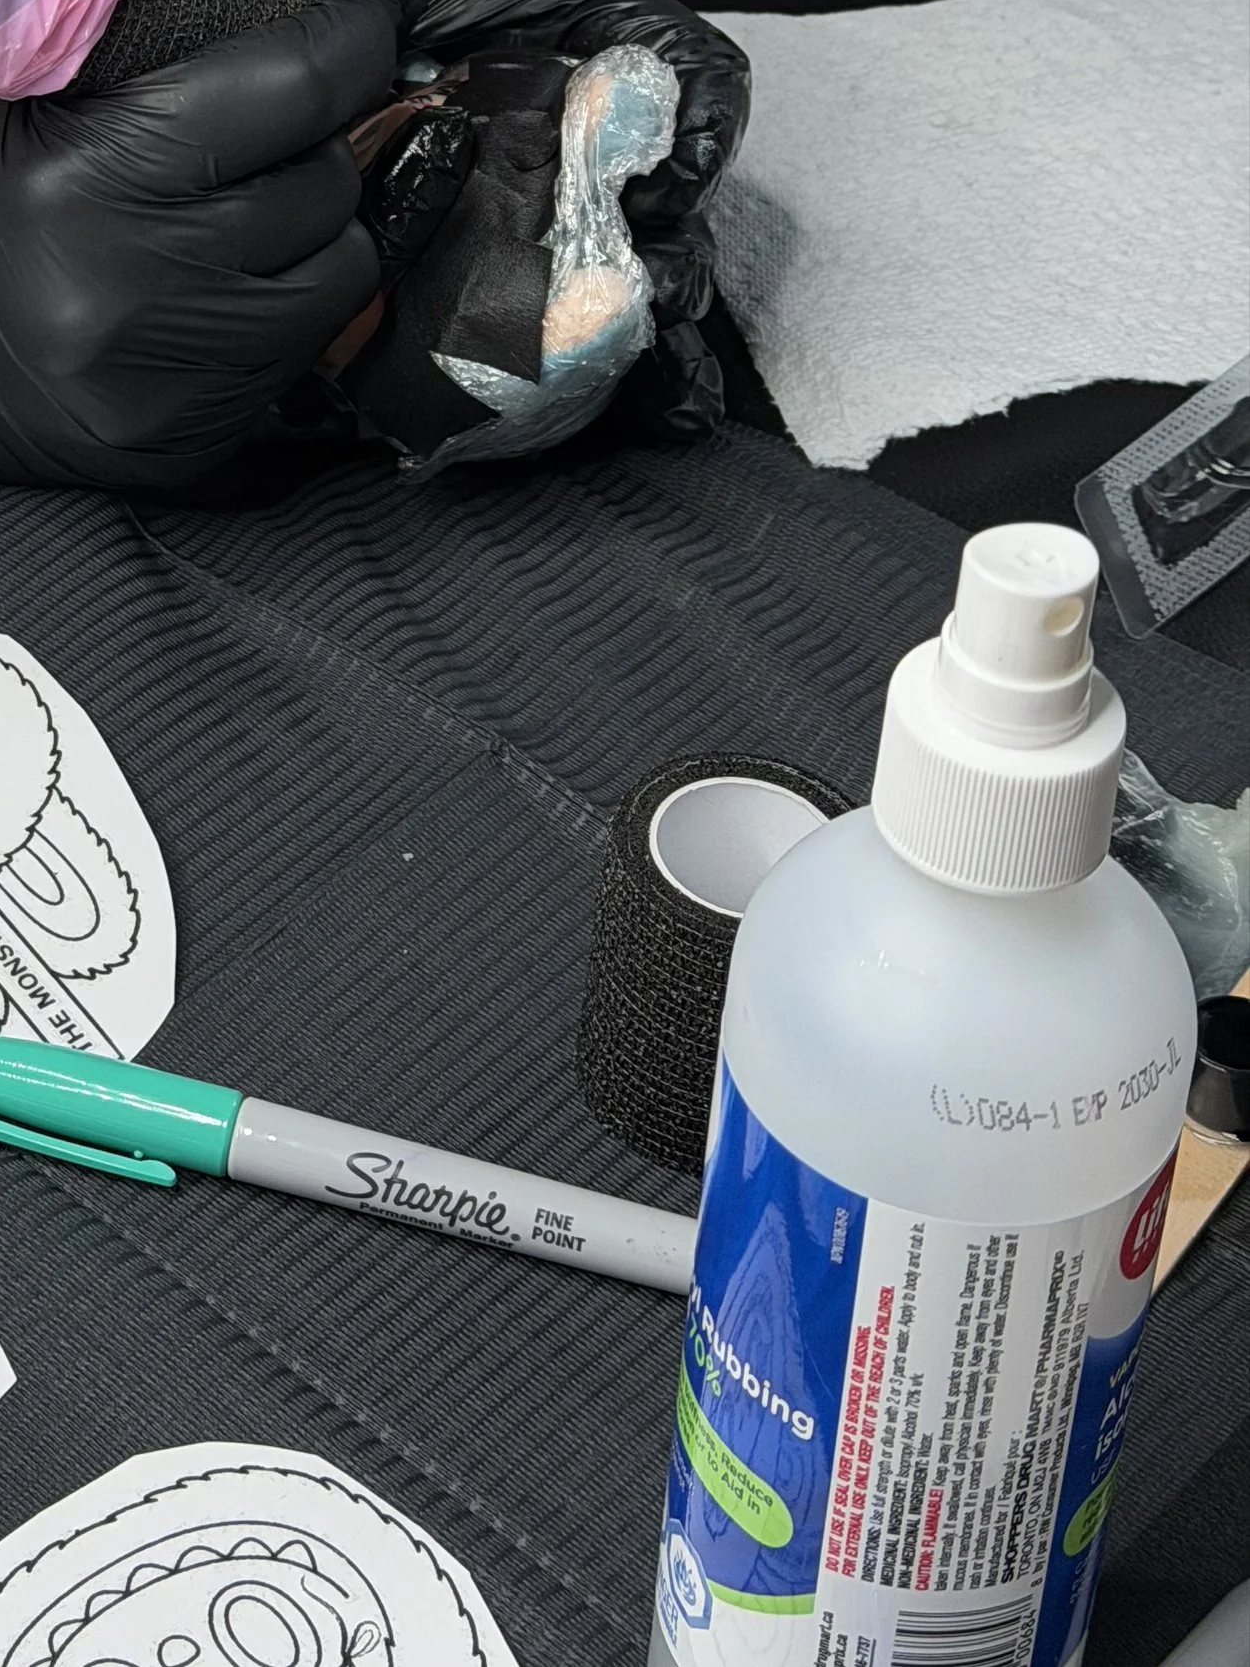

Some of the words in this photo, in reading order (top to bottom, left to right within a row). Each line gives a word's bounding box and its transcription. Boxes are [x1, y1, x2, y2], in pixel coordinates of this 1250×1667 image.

[359, 1201, 443, 1230] Permanent
[459, 1228, 515, 1249] Marker
[534, 1208, 574, 1232] FINE
[531, 1226, 586, 1252] POINT
[909, 1234, 924, 1250] rub
[986, 1235, 1001, 1257] other
[1006, 1242, 1018, 1257] use
[907, 1250, 922, 1269] and
[984, 1259, 998, 1275] and
[902, 1269, 922, 1291] body
[959, 1253, 981, 1299] Dangerous
[993, 1260, 1015, 1310] Discontinue
[901, 1292, 916, 1302] to
[981, 1278, 996, 1298] eyes
[875, 1286, 895, 1336] CHILDREN.
[975, 1300, 991, 1320] from
[1060, 1278, 1080, 1324] Alberta
[897, 1302, 917, 1327] Apply
[872, 1335, 888, 1350] OF
[955, 1329, 970, 1350] open
[973, 1322, 991, 1343] away
[689, 1312, 721, 1397] 70%
[951, 1351, 966, 1367] and
[967, 1346, 987, 1367] Keep
[985, 1350, 1004, 1374] plenty
[702, 1305, 815, 1440] Rubbing
[850, 1368, 865, 1384] OR
[868, 1350, 886, 1384] REACH
[892, 1355, 907, 1378] parts
[888, 1377, 904, 1386] 3
[889, 1386, 902, 1397] or
[947, 1369, 963, 1397] sparks
[845, 1383, 863, 1424] BROKEN
[865, 1383, 881, 1403] THE
[886, 1396, 901, 1405] 2
[904, 1389, 922, 1409] 70%
[863, 1403, 878, 1418] OF
[884, 1405, 899, 1424] with
[977, 1396, 994, 1416] rinse
[843, 1423, 858, 1436] IS
[861, 1417, 876, 1439] OUT
[901, 1409, 918, 1441] Alcohol
[938, 1422, 954, 1441] from
[840, 1435, 856, 1456] CAP
[880, 1425, 897, 1448] dilute
[954, 1422, 972, 1460] physician
[857, 1439, 873, 1465] KEEP
[881, 1448, 893, 1459] or
[895, 1441, 916, 1478] Isopropyl
[938, 1444, 954, 1464] away
[837, 1455, 853, 1482] OVER
[875, 1460, 894, 1494] strength
[931, 1466, 951, 1487] Keep
[952, 1462, 966, 1476] call
[968, 1460, 984, 1490] contact
[707, 1451, 718, 1472] to
[721, 1473, 744, 1500] Aid
[747, 1497, 761, 1515] in
[721, 1452, 773, 1508] Reduce
[1031, 1467, 1048, 1493] M2J
[834, 1484, 850, 1507] SEAL
[851, 1490, 867, 1510] USE
[871, 1494, 886, 1508] full
[1028, 1493, 1043, 1514] ON
[832, 1505, 846, 1518] IF
[869, 1509, 885, 1526] Use
[994, 1511, 1009, 1524] for
[1000, 1491, 1028, 1584] SHOPPERS
[1016, 1439, 1037, 1490] DRUG
[830, 1517, 845, 1537] USE
[844, 1512, 864, 1558] EXTERNAL
[827, 1536, 842, 1557] NOT
[897, 1518, 921, 1590] NON-MEDICINAL
[983, 1524, 1006, 1588] Manufactured
[825, 1556, 840, 1573] DO
[841, 1557, 857, 1578] FOR
[879, 1538, 900, 1587] MEDICINAL
[972, 1562, 984, 1570] or
[934, 1570, 949, 1592] taken
[952, 1559, 968, 1591] mucous
[969, 1571, 982, 1589] rash
